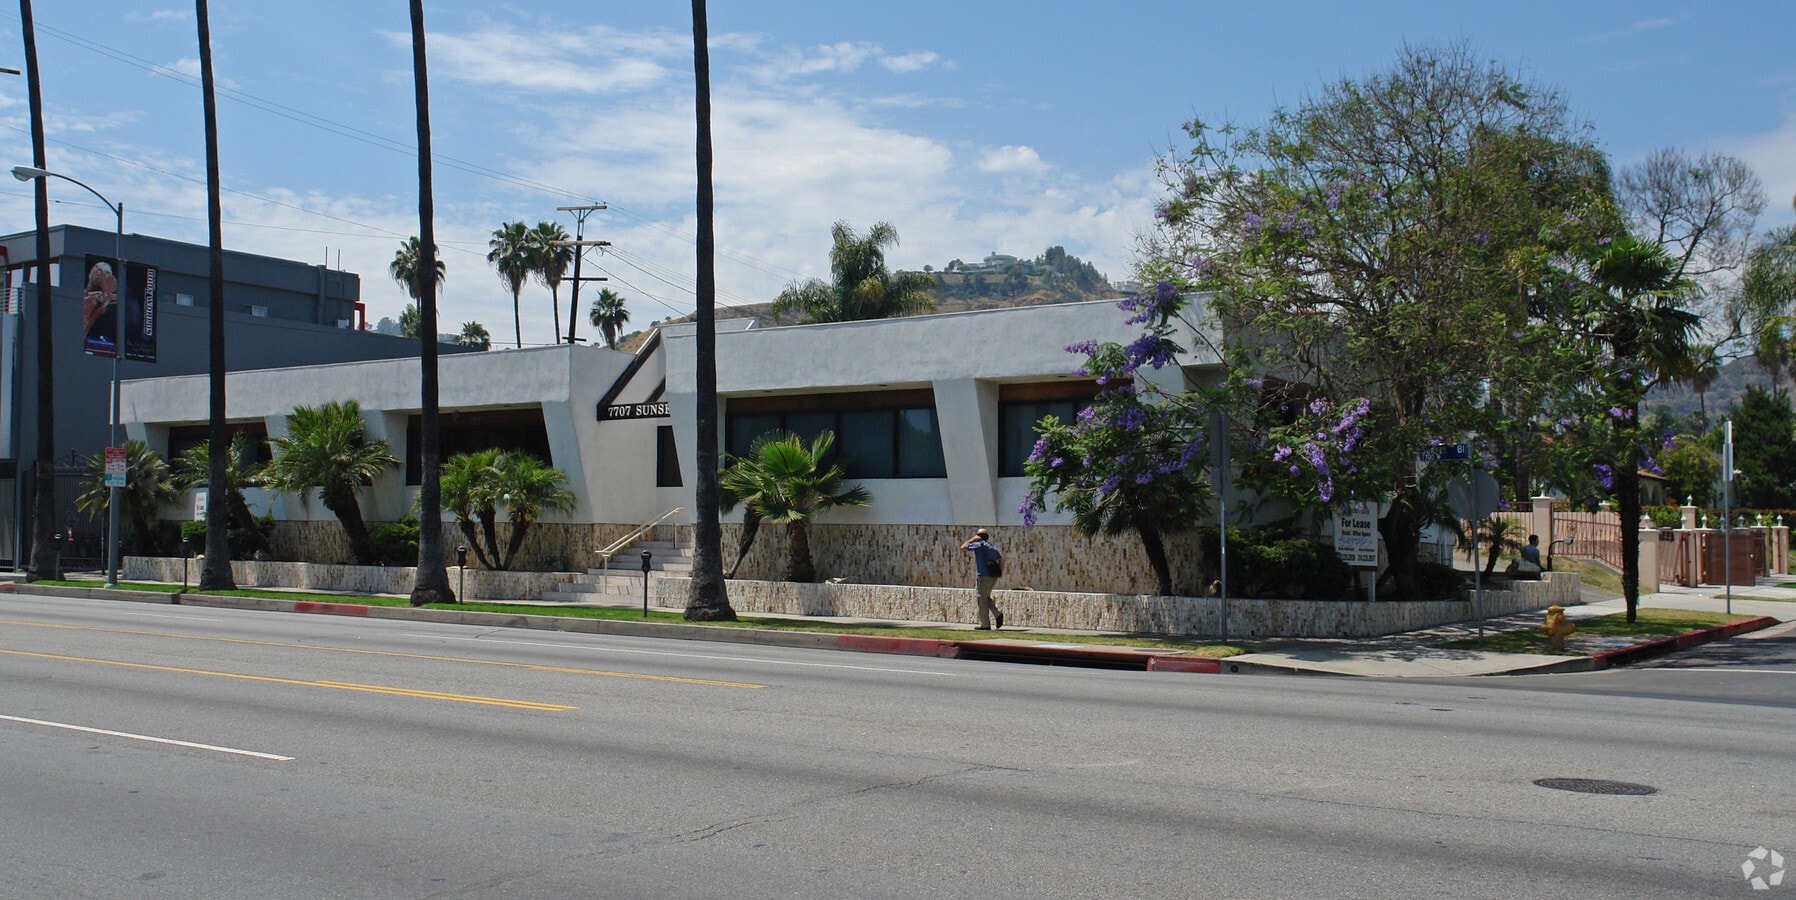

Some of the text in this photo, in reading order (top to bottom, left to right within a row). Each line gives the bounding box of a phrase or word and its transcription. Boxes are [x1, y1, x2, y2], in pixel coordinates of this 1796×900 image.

[608, 406, 631, 417] 7707
[1341, 517, 1371, 529] For Lease
